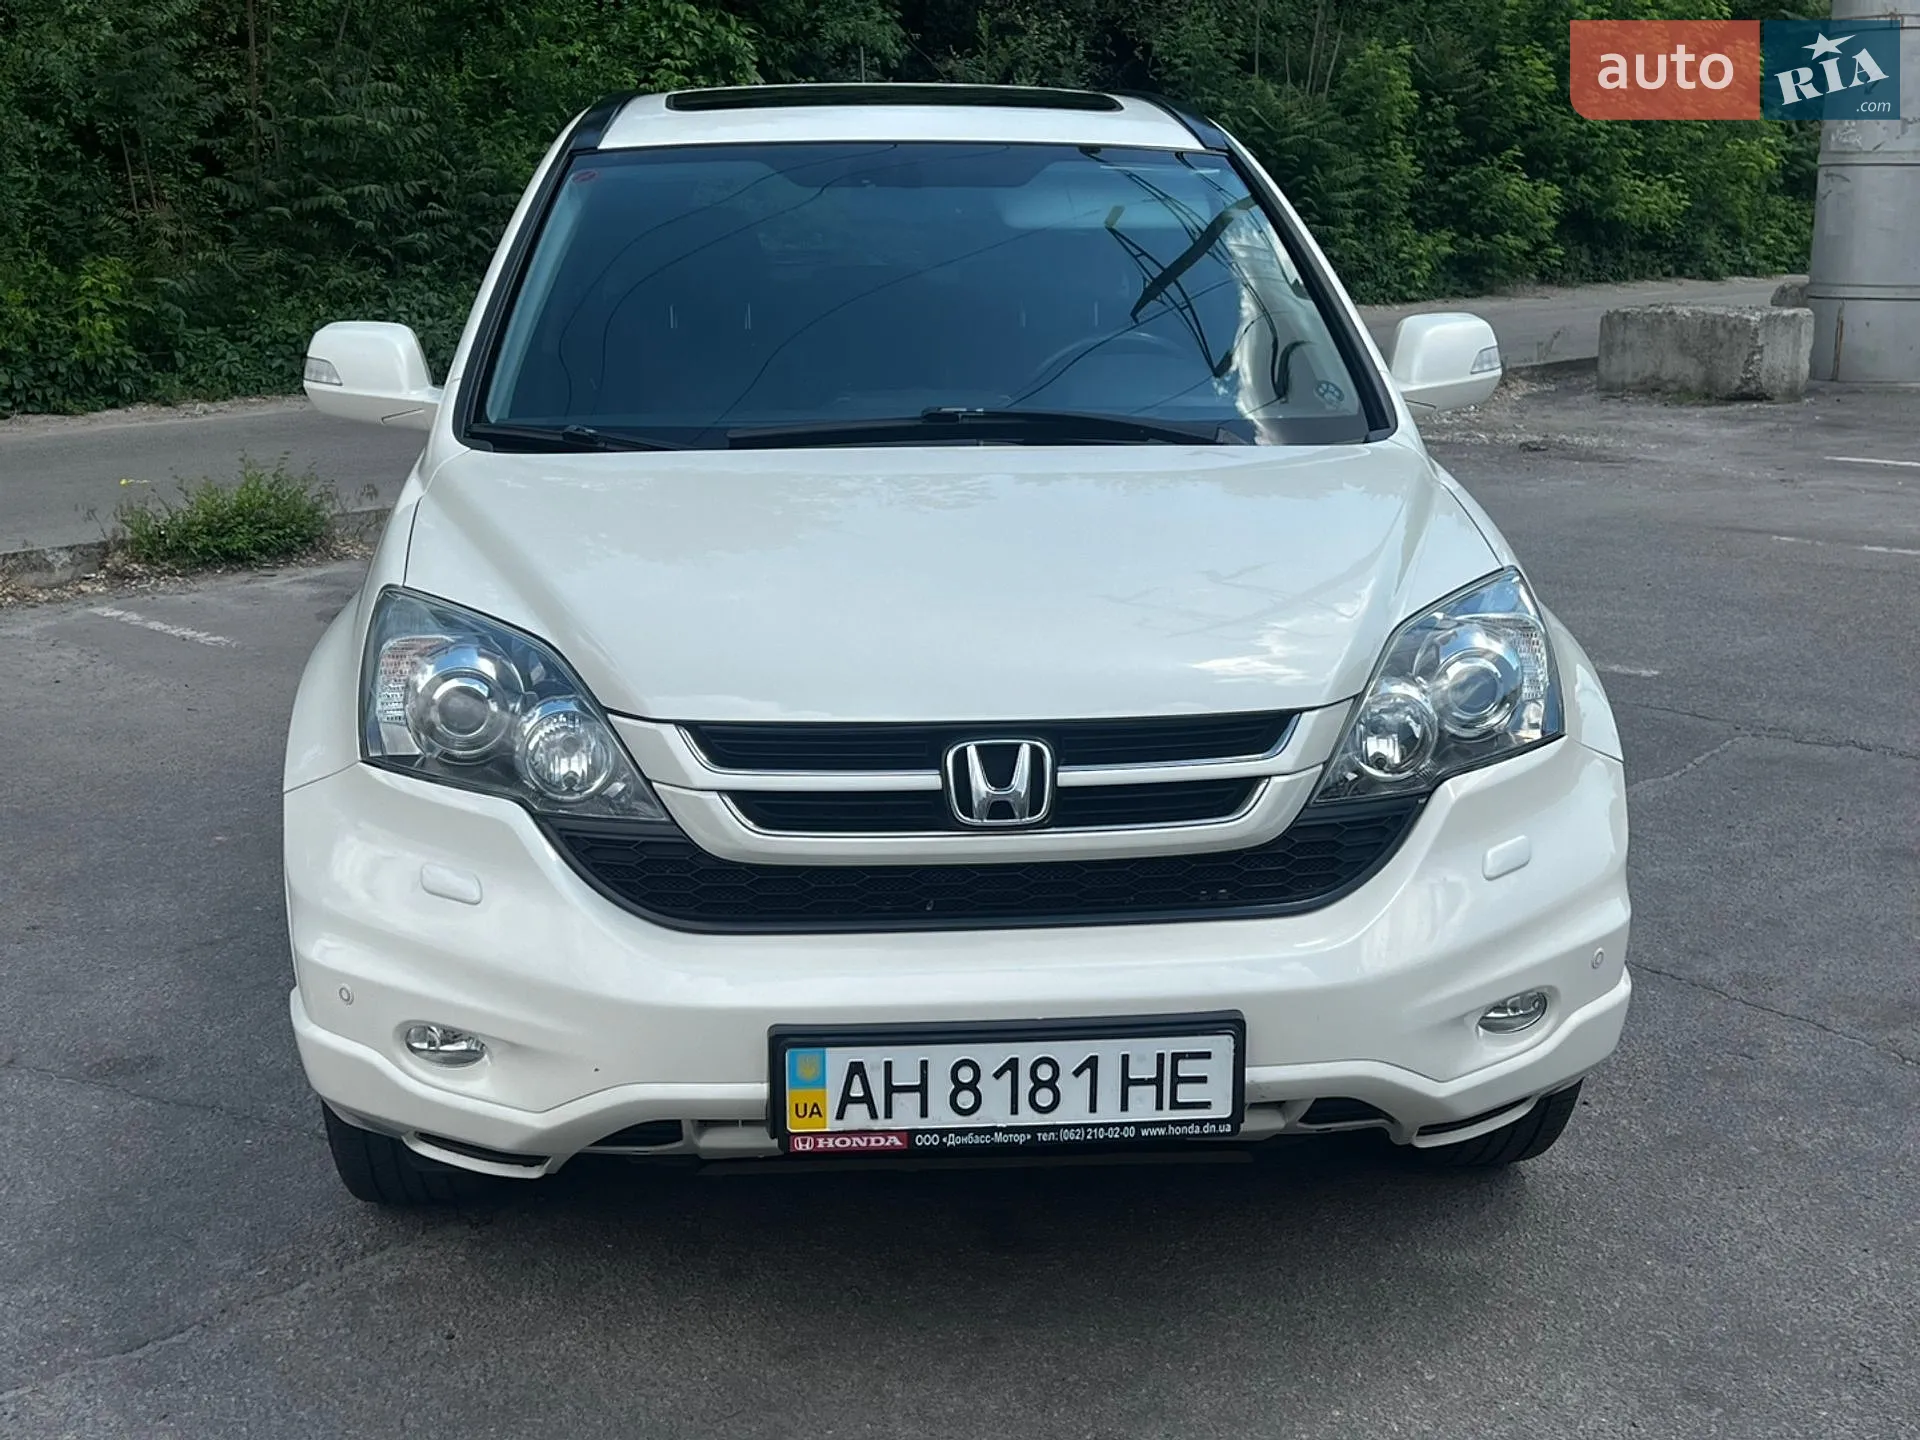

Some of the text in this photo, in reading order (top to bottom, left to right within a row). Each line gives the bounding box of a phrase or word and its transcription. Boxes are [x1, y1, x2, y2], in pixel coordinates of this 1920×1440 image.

[949, 1053, 1099, 1117] 8181
[794, 1103, 823, 1119] UA
[817, 1134, 903, 1148] HONDA
[915, 1134, 940, 1146] ООО
[942, 1132, 1032, 1145] «Донбасс-Мотор»
[1086, 1126, 1136, 1140] 210-02-00
[1140, 1122, 1232, 1137] www.honda.dn.ua
